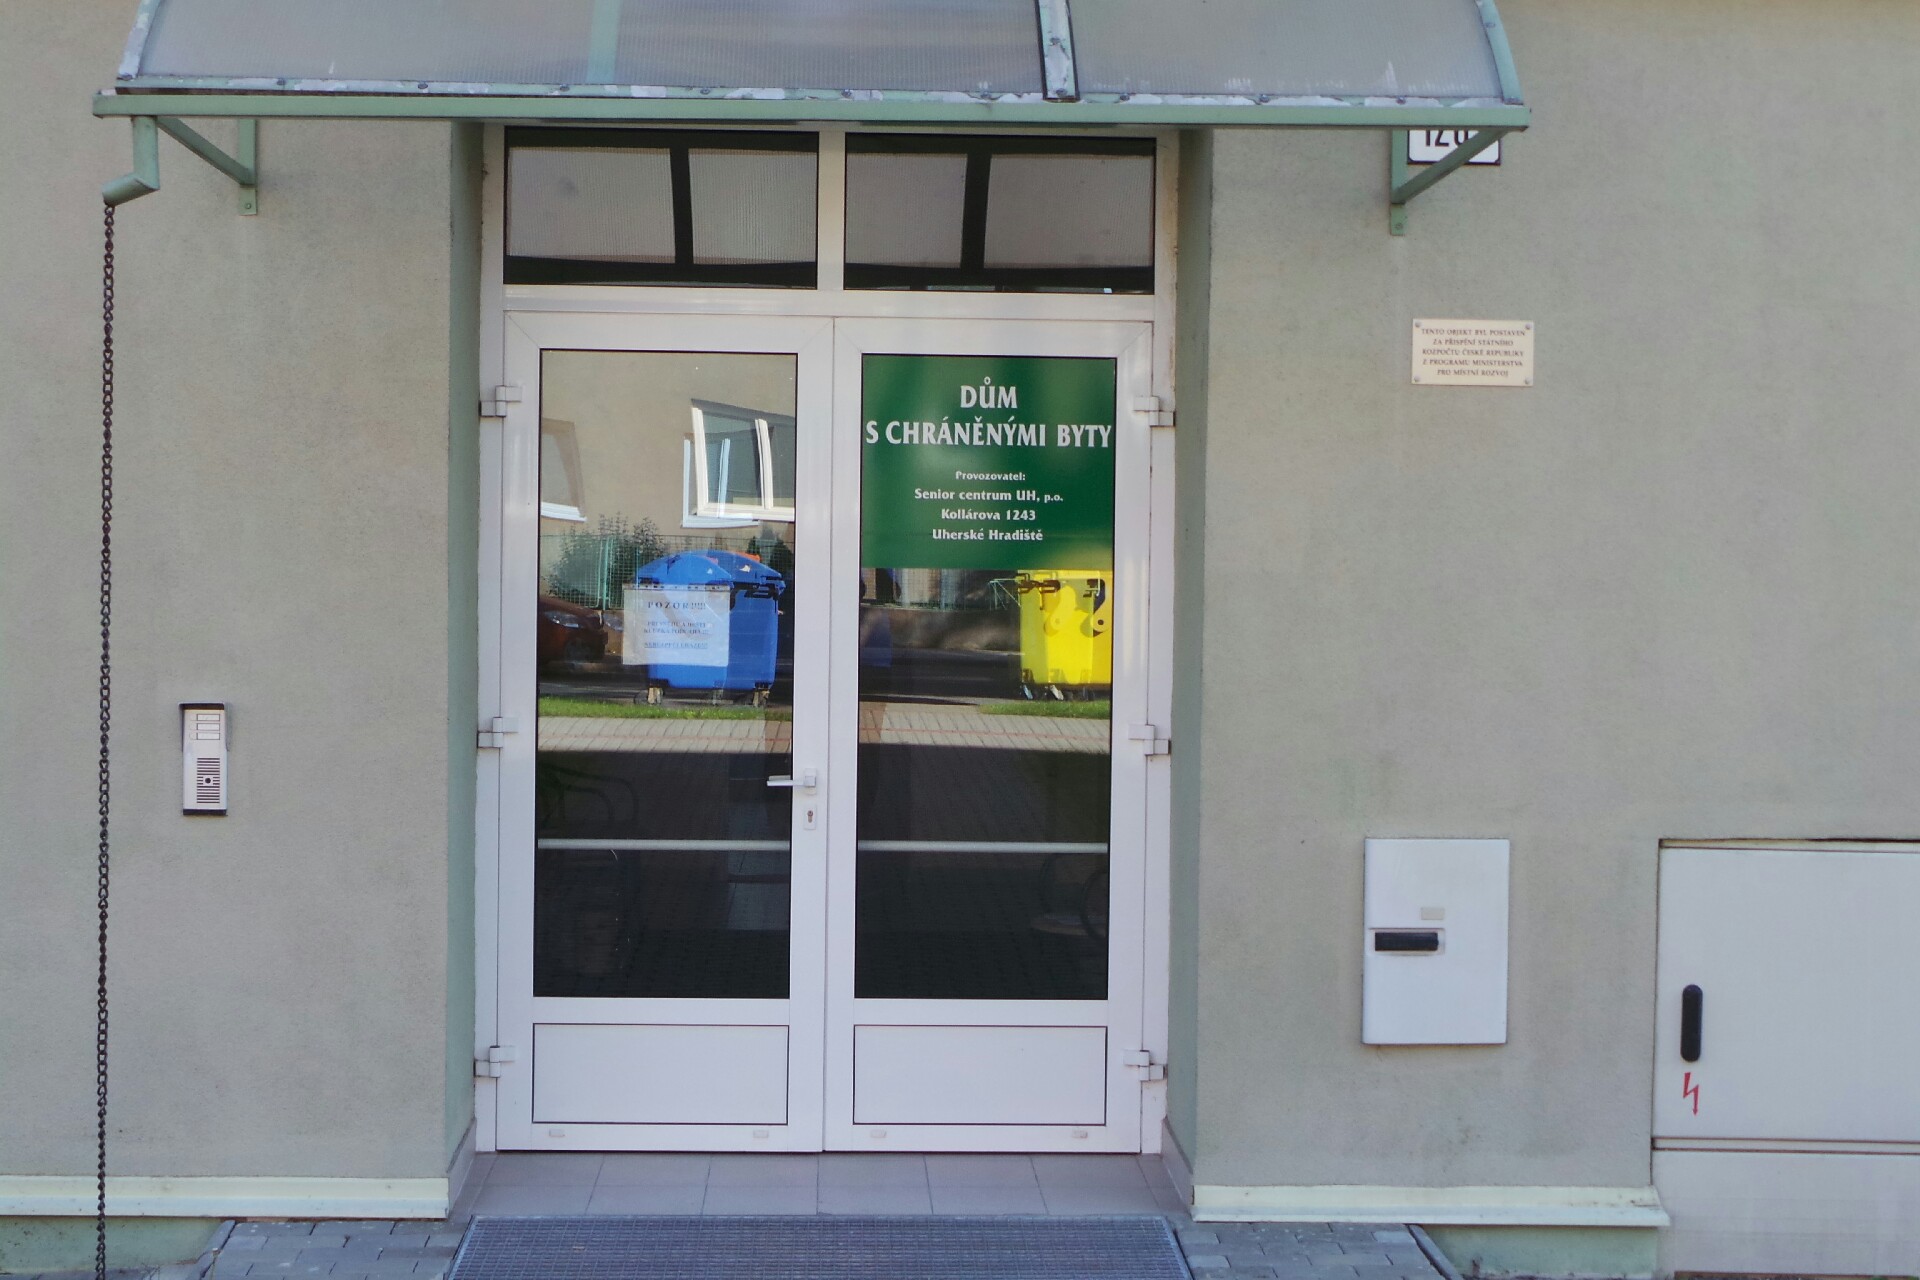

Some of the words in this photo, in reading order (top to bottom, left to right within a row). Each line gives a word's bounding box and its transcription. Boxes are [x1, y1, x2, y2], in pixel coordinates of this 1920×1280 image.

[960, 376, 1018, 409] DŮM
[866, 420, 879, 444] S
[885, 416, 1046, 446] CHRÁNĚNÝMI
[1057, 425, 1112, 448] BYTY
[955, 471, 1026, 480] Provozovatel:
[914, 488, 955, 500] Senior
[959, 490, 1012, 501] centrum
[1016, 490, 1040, 502] UH,
[1044, 494, 1064, 503] p.o.
[941, 508, 1000, 520] Kollárova
[1006, 509, 1036, 521] 1243
[932, 528, 984, 540] Uherské
[989, 529, 1044, 540] Hradiště
